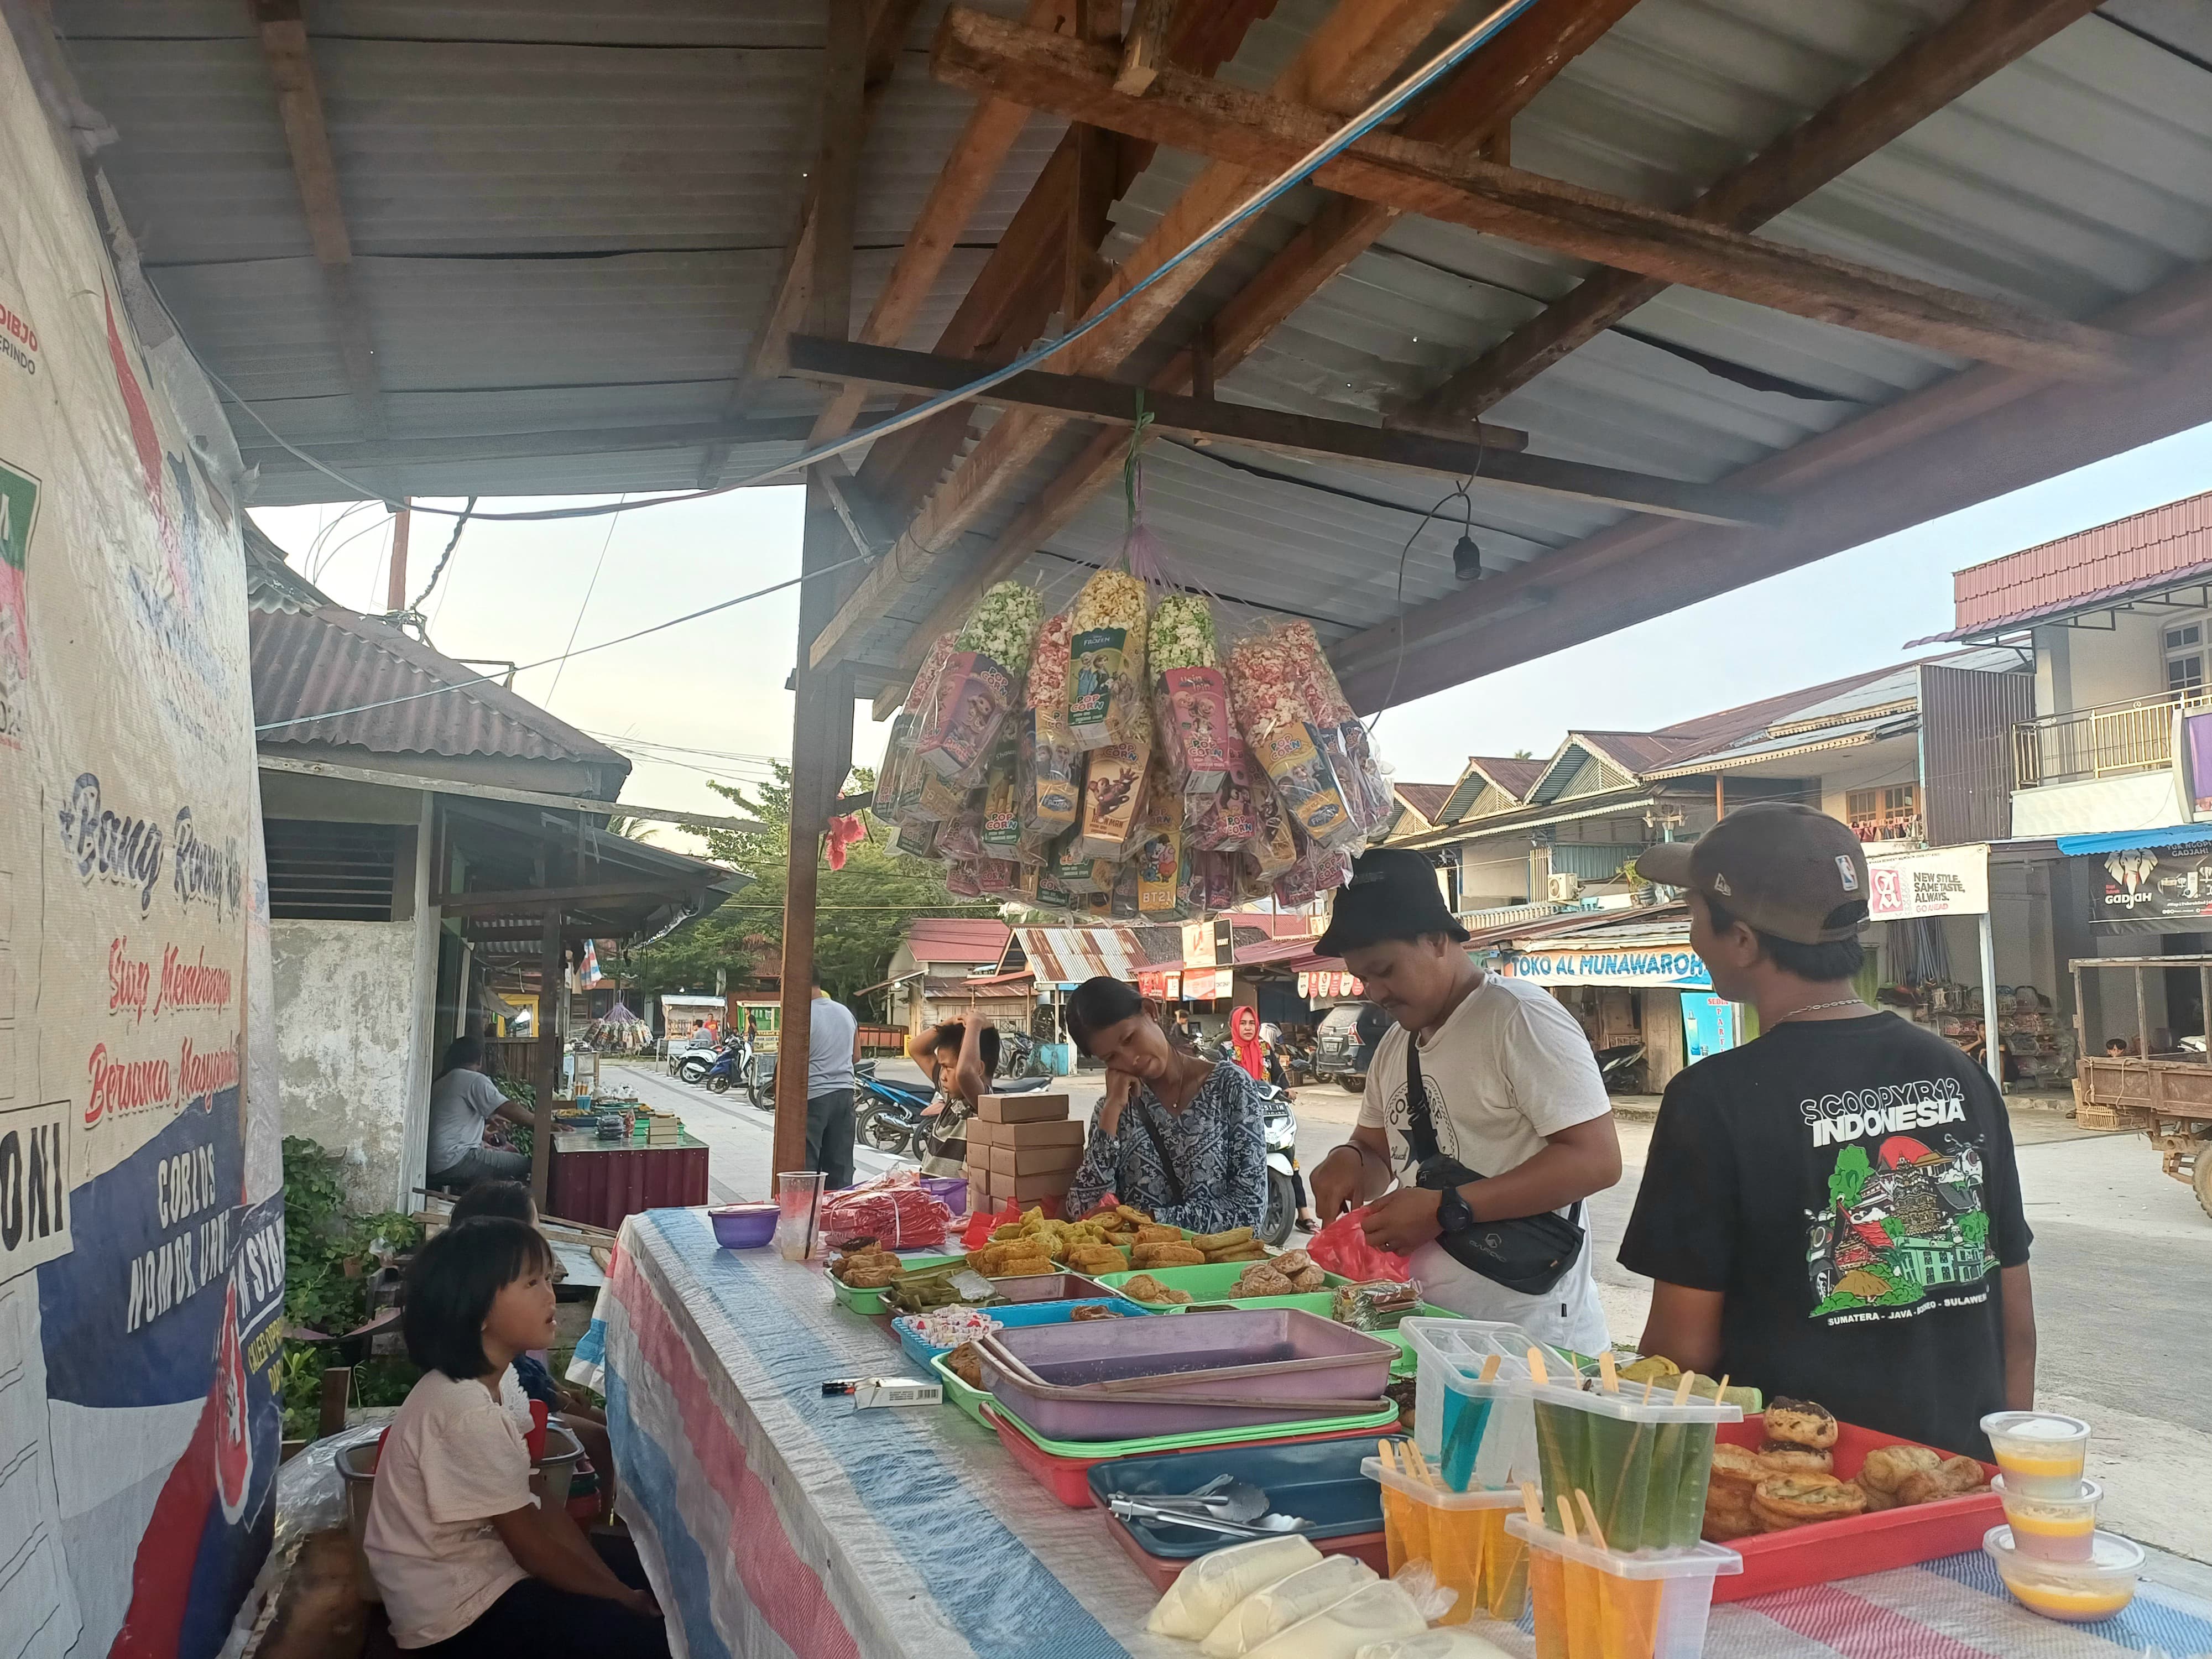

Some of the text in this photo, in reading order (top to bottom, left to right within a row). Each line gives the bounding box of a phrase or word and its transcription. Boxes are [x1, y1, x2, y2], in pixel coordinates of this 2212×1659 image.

[0, 335, 35, 375] RINDO
[1083, 637, 1110, 646] FROZEN
[989, 666, 1009, 687] POP
[980, 671, 1008, 697] CORN
[1077, 694, 1100, 704] POP
[1071, 702, 1104, 712] CORN
[1192, 740, 1217, 749] POP
[1270, 734, 1292, 751] POP
[1104, 748, 1138, 761] CORN
[1188, 748, 1223, 758] CORN
[1270, 739, 1301, 761] CORN
[992, 812, 1013, 822] POP
[1227, 816, 1246, 825] POP
[985, 821, 1018, 830] CORN
[1108, 820, 1124, 829] MAN
[1228, 823, 1253, 836] CORN
[2172, 848, 2209, 857] GADJAH!
[1318, 858, 1337, 872] POP
[1913, 872, 1935, 882] NEW
[1914, 883, 1965, 893] SAME TASTE,
[1142, 891, 1171, 903] BT21
[1914, 893, 1950, 903] ALWAYS.
[1928, 903, 1949, 911] AHEAD
[1511, 953, 1704, 977] TOKO AL MUNAWAROH
[85, 1042, 172, 1124] Bersama
[1801, 1077, 1965, 1126] SCOOPYR12
[1812, 1097, 1967, 1148] INDONESIA
[0, 1122, 63, 1251] ONI
[158, 1142, 216, 1229] COBLOS
[127, 1231, 196, 1334] NOMOR
[1828, 1312, 1880, 1326] SUMATERA
[1888, 1309, 1913, 1319] JAVA
